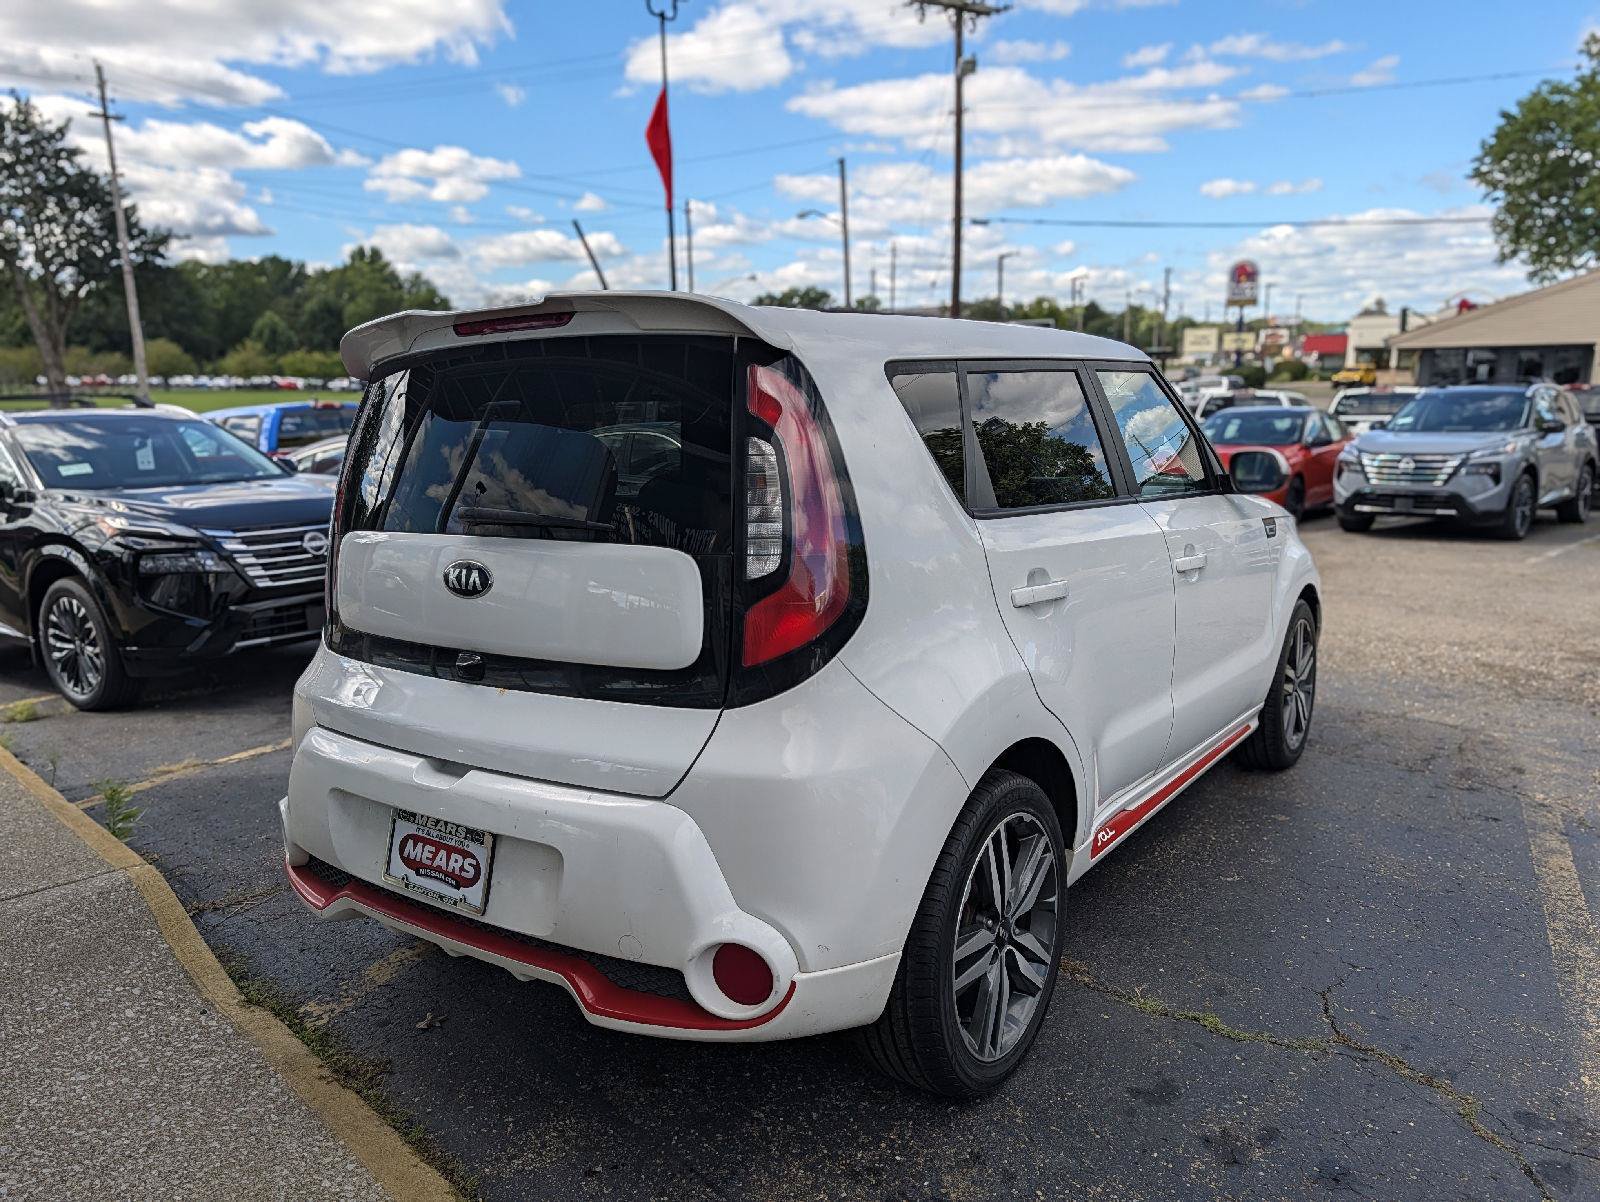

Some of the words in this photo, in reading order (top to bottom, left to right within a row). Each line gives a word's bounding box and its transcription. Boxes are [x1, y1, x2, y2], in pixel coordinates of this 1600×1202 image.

[449, 568, 482, 591] KIA
[415, 814, 467, 839] MEARS
[436, 833, 454, 844] ABOUT
[402, 838, 478, 879] MEARS
